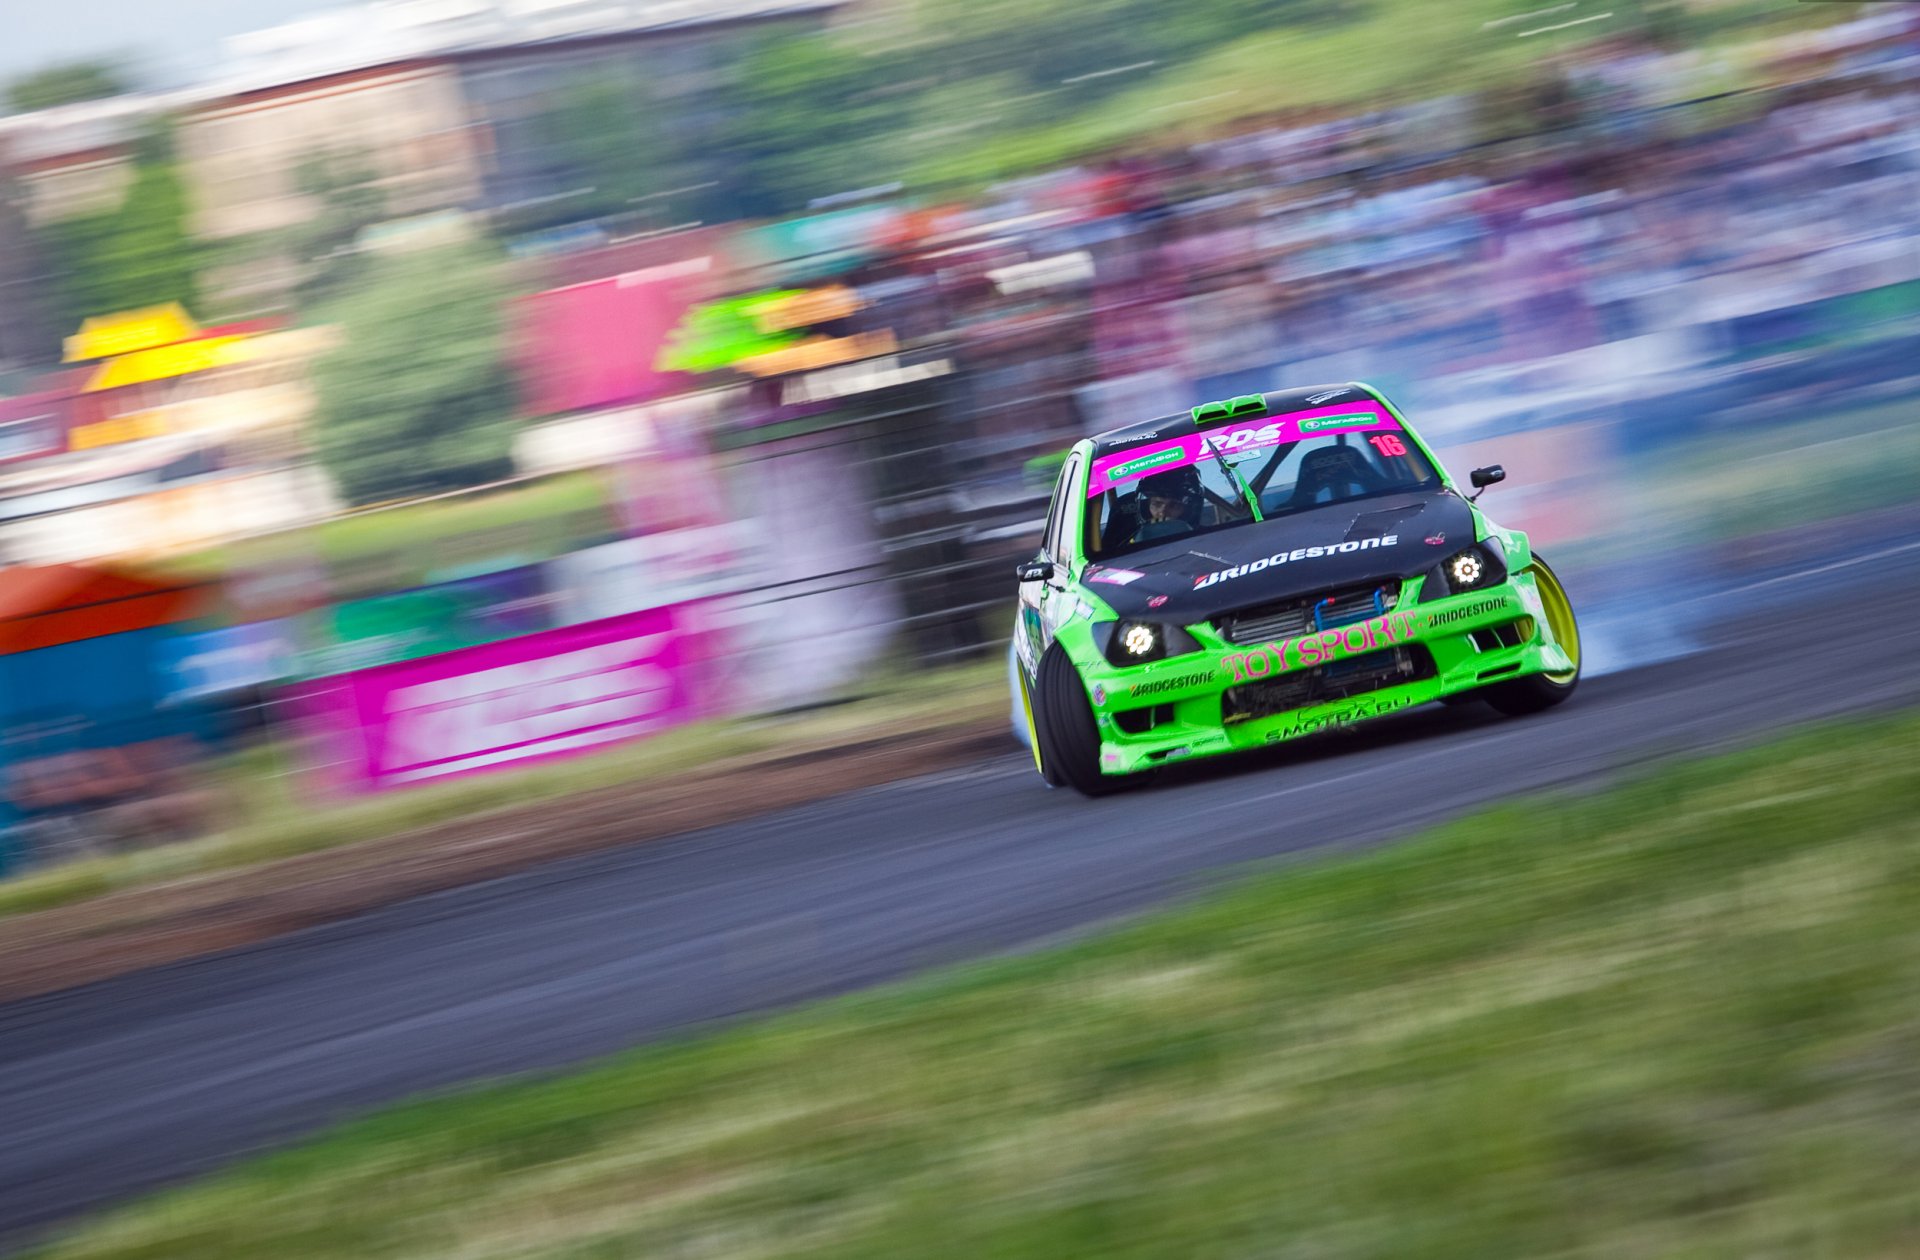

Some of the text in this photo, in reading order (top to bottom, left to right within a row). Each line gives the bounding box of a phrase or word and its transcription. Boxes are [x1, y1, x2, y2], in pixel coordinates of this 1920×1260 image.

[1199, 422, 1286, 455] RDS
[1369, 434, 1407, 456] 16
[1193, 535, 1398, 591] BRIDGESTONE
[1428, 597, 1508, 629] BRIDGESTONE
[1221, 609, 1416, 683] TOY SPORT
[1130, 670, 1216, 697] BRIDGESTONE
